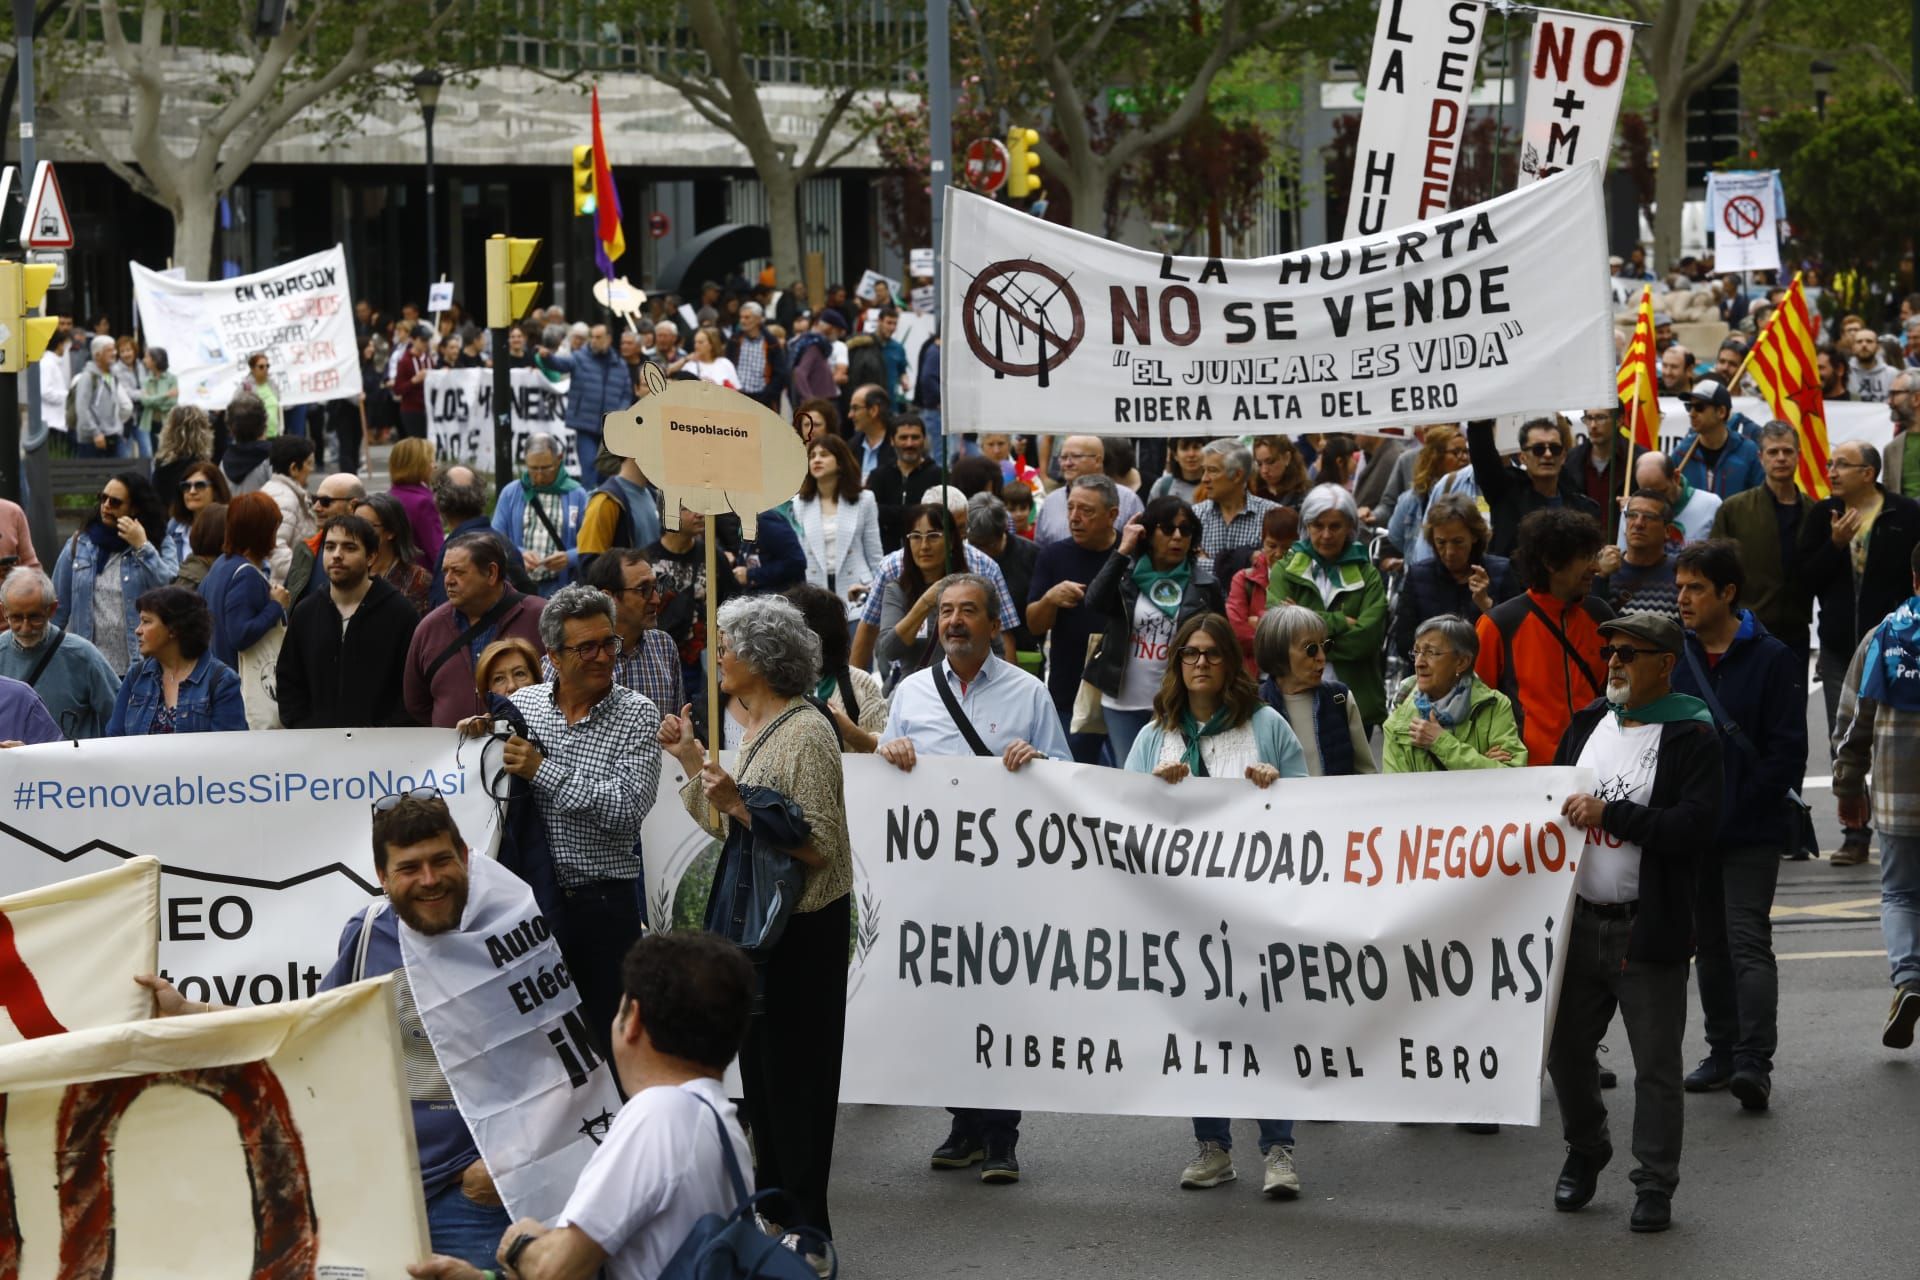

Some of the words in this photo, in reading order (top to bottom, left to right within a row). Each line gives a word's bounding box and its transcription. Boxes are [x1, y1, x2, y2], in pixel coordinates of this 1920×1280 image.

[1533, 21, 1624, 87] NO
[1159, 254, 1228, 285] LA
[1278, 211, 1498, 286] HUERTA
[235, 285, 255, 303] EN
[1109, 284, 1202, 347] NO
[1222, 300, 1298, 344] SE
[1323, 265, 1511, 338] VENDE
[1182, 352, 1339, 386] JUNCAR
[1351, 343, 1400, 380] ES
[430, 386, 469, 423] LOS
[1114, 395, 1213, 423] RIBERA
[1232, 393, 1302, 421] ALTA
[1321, 390, 1372, 418] DEL
[1390, 382, 1459, 413] EBRO
[670, 420, 749, 438] Despoblación
[1896, 663, 1920, 680] Per
[886, 804, 940, 863] NO
[954, 807, 1000, 868] ES
[1015, 808, 1330, 886] SOSTENIBILIDAD.
[1343, 826, 1384, 888] ES
[1396, 820, 1577, 885] NEGOCIO.
[158, 895, 254, 941] EO
[899, 918, 1187, 998] RENOVABLES
[1258, 940, 1389, 1013] ¡PERO
[1402, 938, 1474, 1003] NO
[1293, 1043, 1364, 1079] DEL
